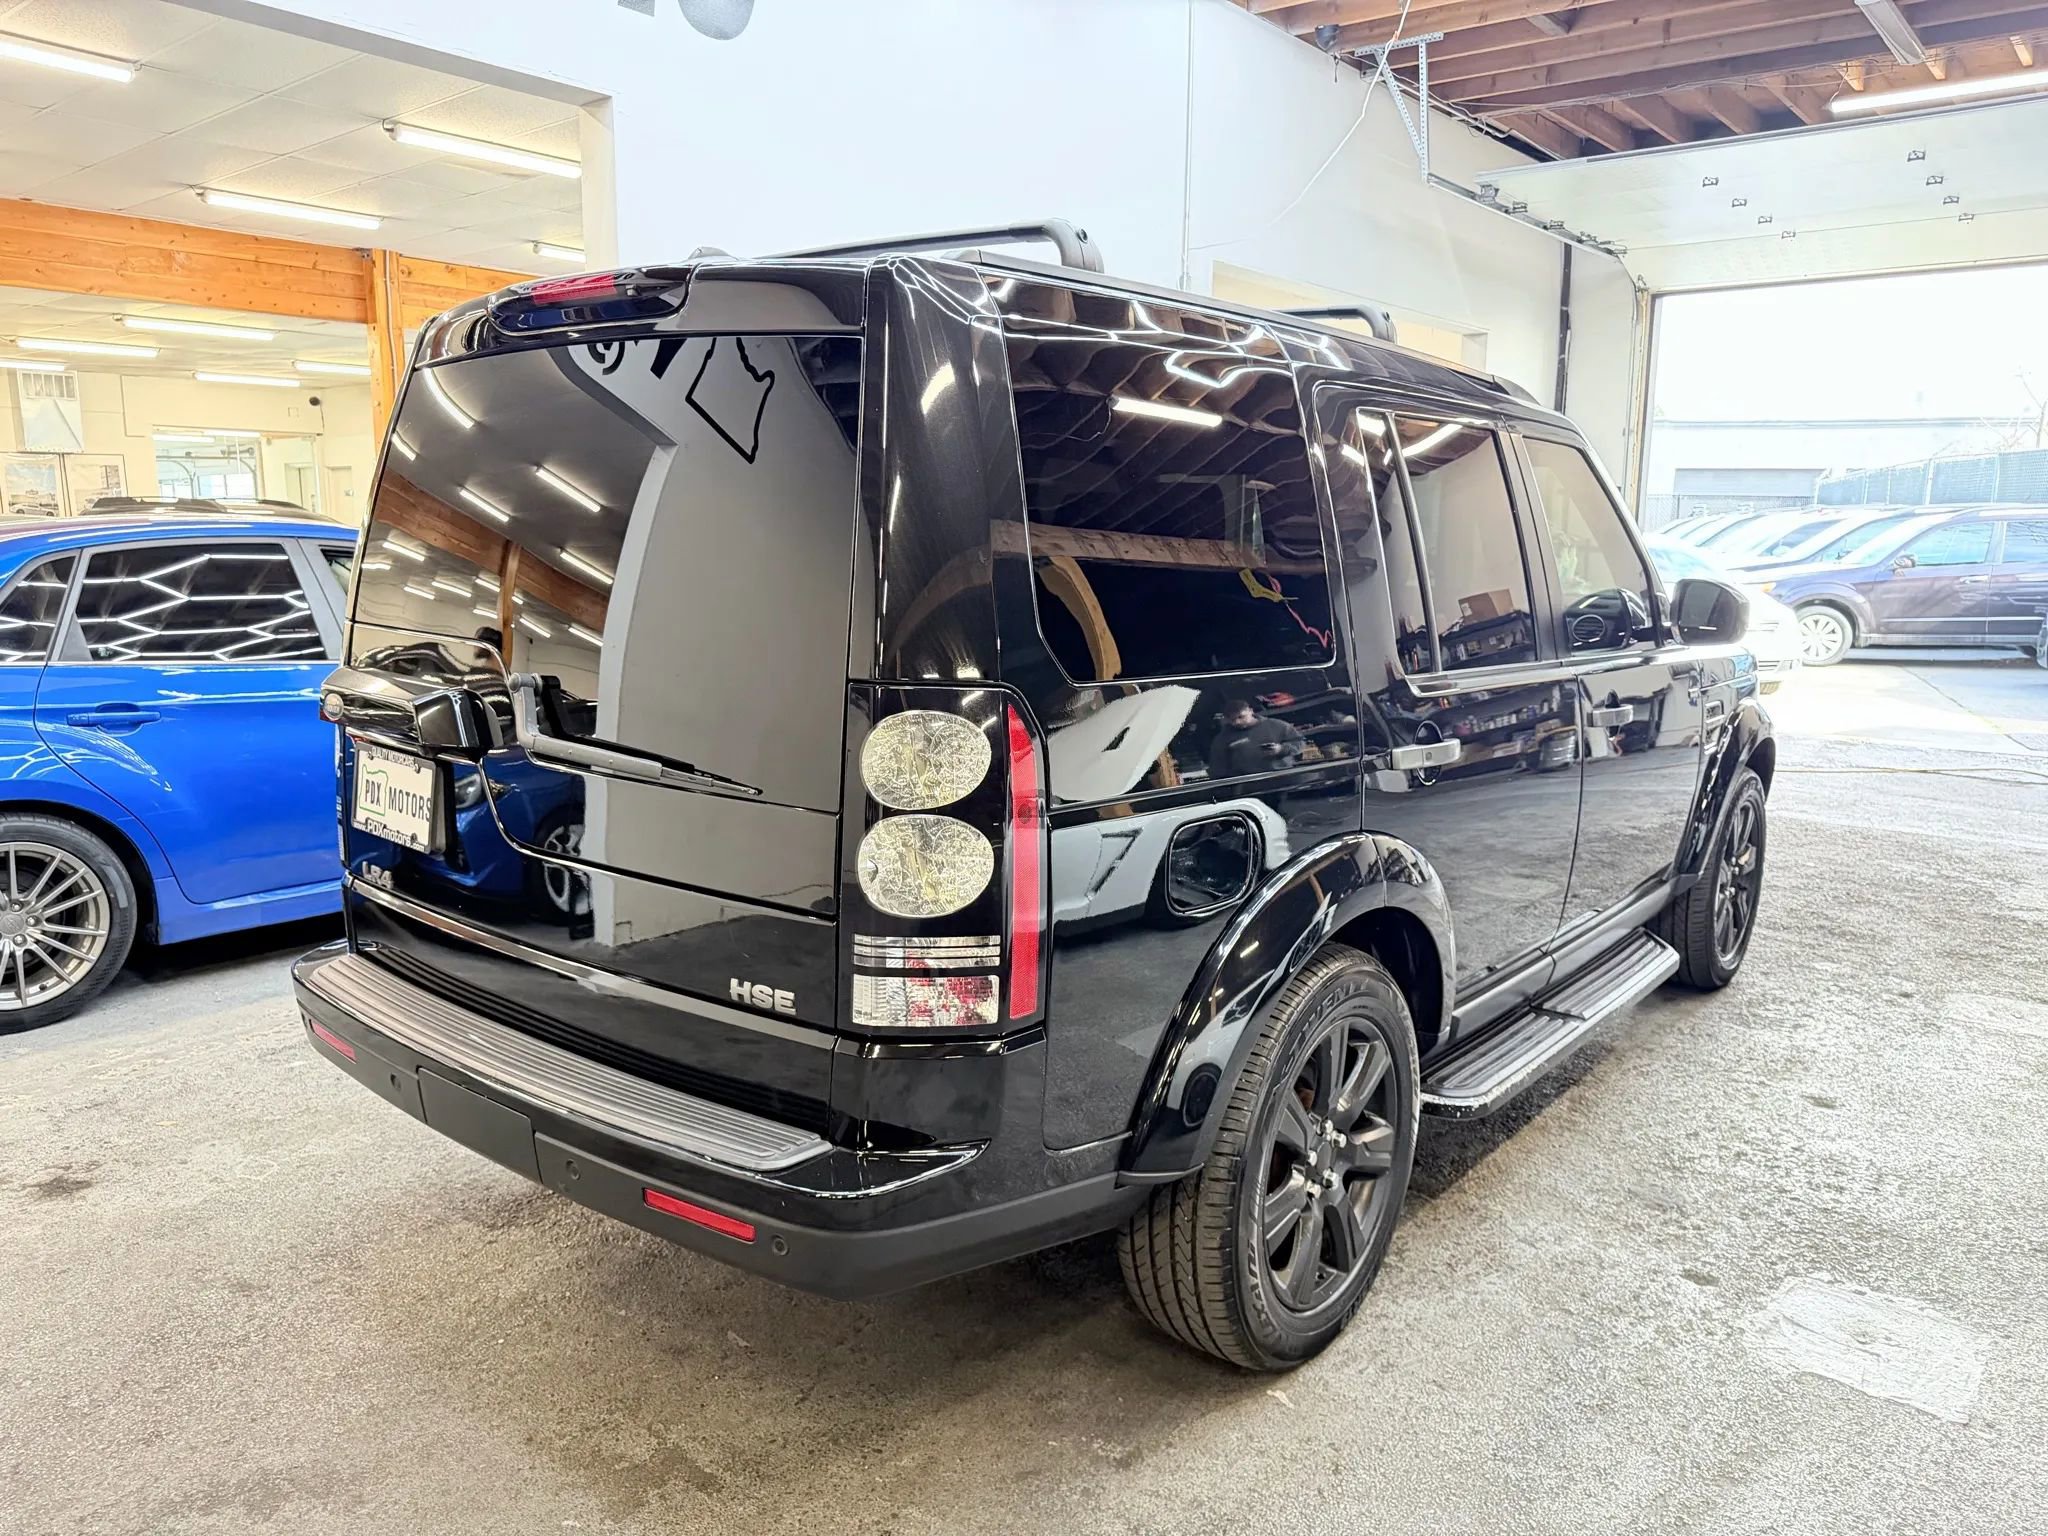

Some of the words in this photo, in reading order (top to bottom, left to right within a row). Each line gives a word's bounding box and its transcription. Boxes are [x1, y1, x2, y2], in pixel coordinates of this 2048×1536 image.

[365, 779, 381, 807] PDX
[388, 786, 432, 822] MOTORS
[362, 861, 393, 889] LR4
[729, 978, 797, 1015] HSE
